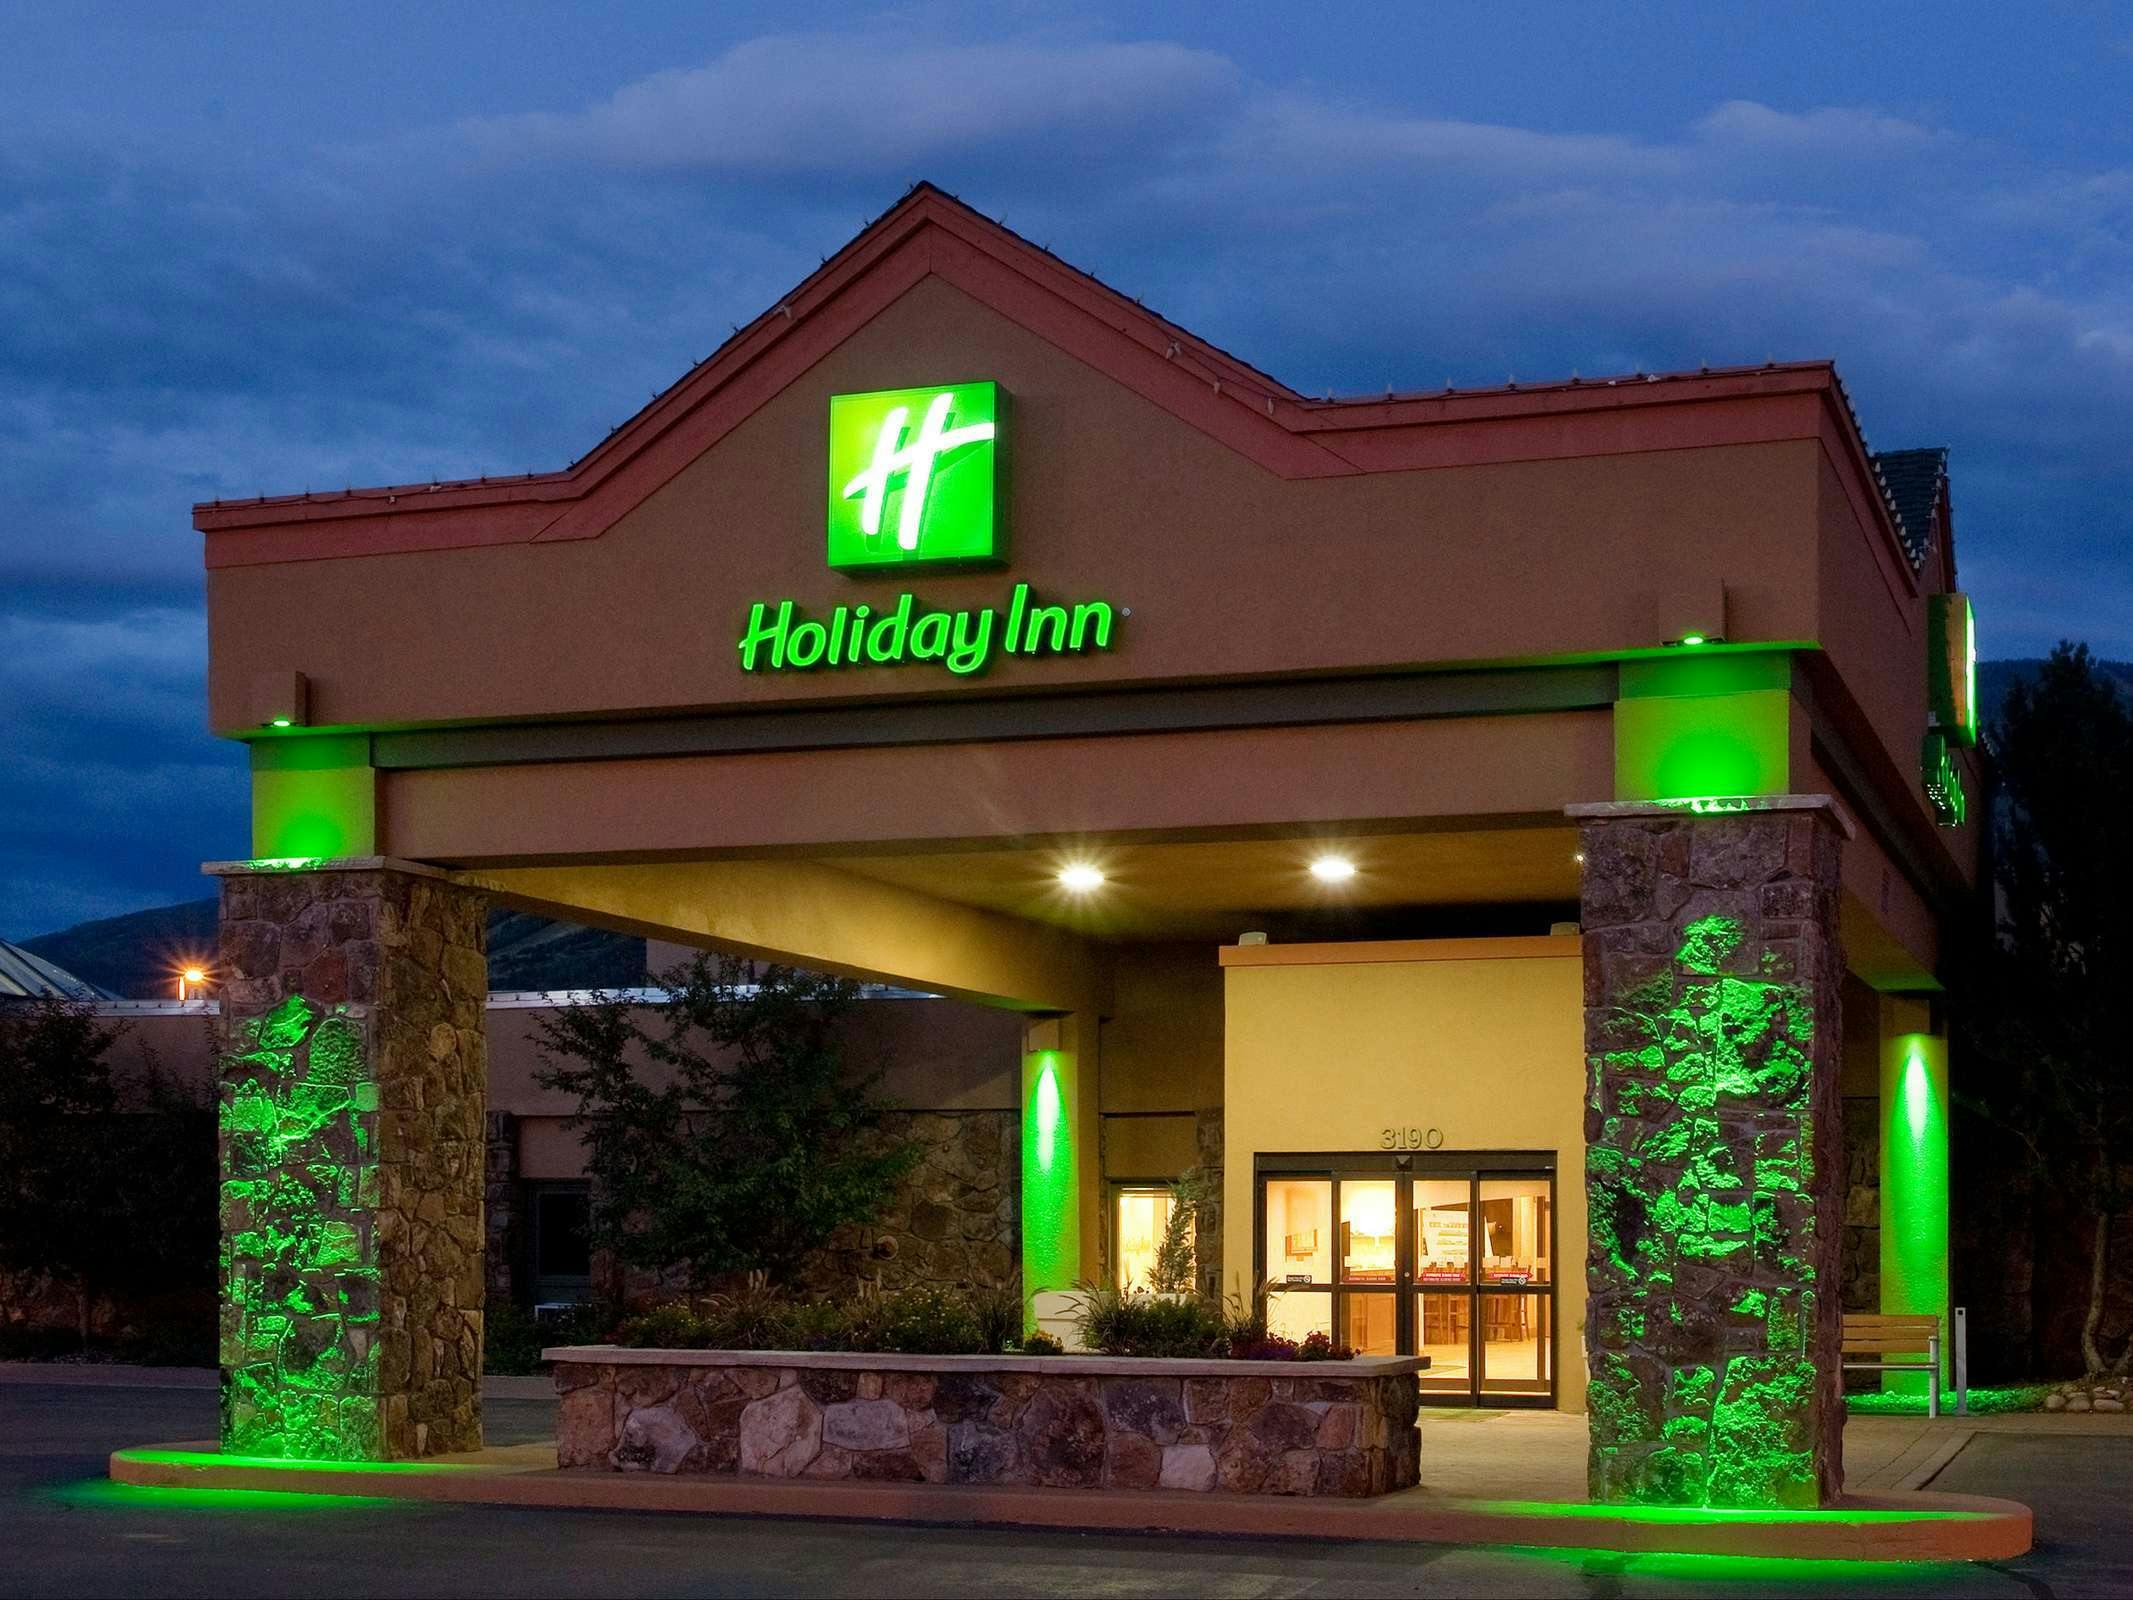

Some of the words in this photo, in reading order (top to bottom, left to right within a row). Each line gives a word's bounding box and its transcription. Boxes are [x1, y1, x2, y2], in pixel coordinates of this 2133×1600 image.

[738, 594, 993, 674] Holiday
[1004, 583, 1113, 654] Inn
[1380, 1127, 1444, 1150] 3190
